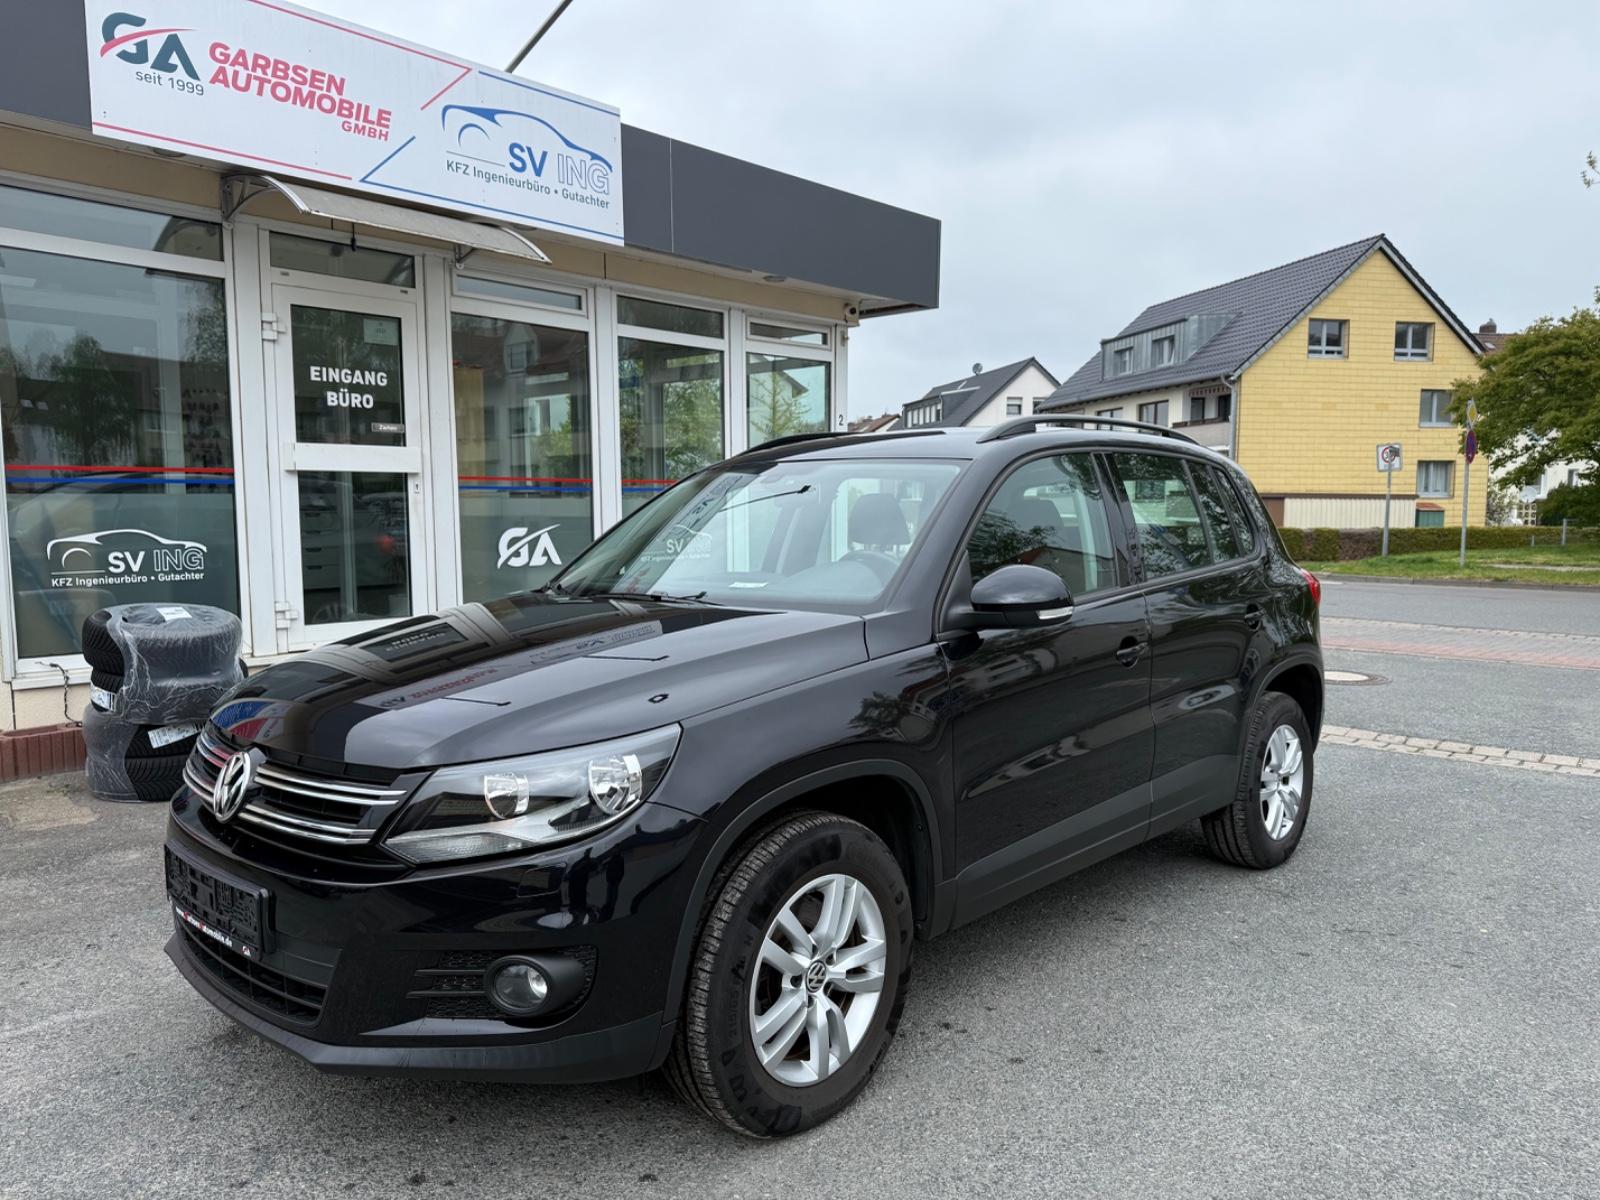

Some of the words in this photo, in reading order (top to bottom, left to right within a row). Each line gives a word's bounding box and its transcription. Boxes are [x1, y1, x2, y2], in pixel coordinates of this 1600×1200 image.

[208, 41, 346, 96] GARBSEN
[135, 69, 163, 86] seit
[168, 77, 205, 96] 1999
[208, 65, 392, 130] AUTOMOBILE
[341, 120, 389, 142] GMBH
[508, 142, 548, 177] SV
[557, 153, 610, 195] ING
[446, 159, 470, 176] KFZ
[473, 166, 551, 195] Ingenieurbüro
[561, 188, 610, 209] Gutachter
[310, 366, 388, 387] EINGANG
[326, 388, 374, 409] BÜRO
[838, 414, 844, 426] 2
[108, 551, 145, 573] SV
[153, 548, 204, 572] ING
[51, 577, 73, 587] KFZ
[76, 574, 148, 587] Ingenieurbüro
[158, 572, 204, 582] Gutachter
